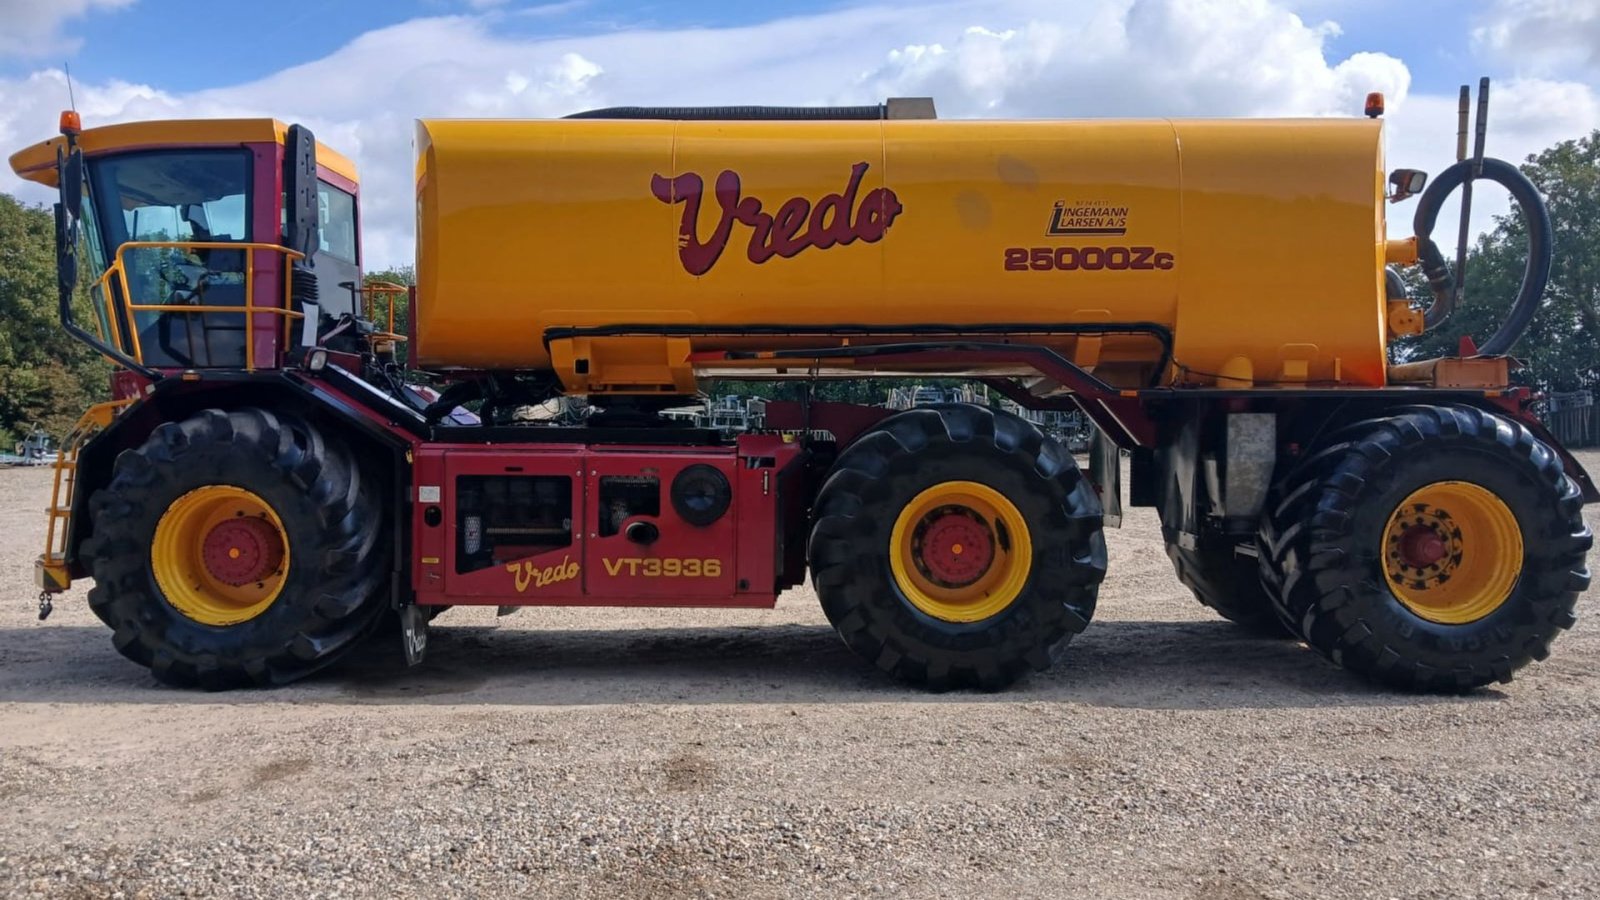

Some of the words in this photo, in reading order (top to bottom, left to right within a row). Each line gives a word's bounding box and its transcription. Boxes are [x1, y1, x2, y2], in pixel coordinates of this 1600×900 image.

[650, 161, 903, 276] Vredo
[1060, 218, 1103, 227] LARSEN
[1106, 218, 1126, 227] A/S
[1063, 207, 1128, 217] INGEMANN
[1004, 246, 1174, 271] 25000Zc
[506, 555, 580, 593] Vredo
[602, 557, 721, 577] VT3936
